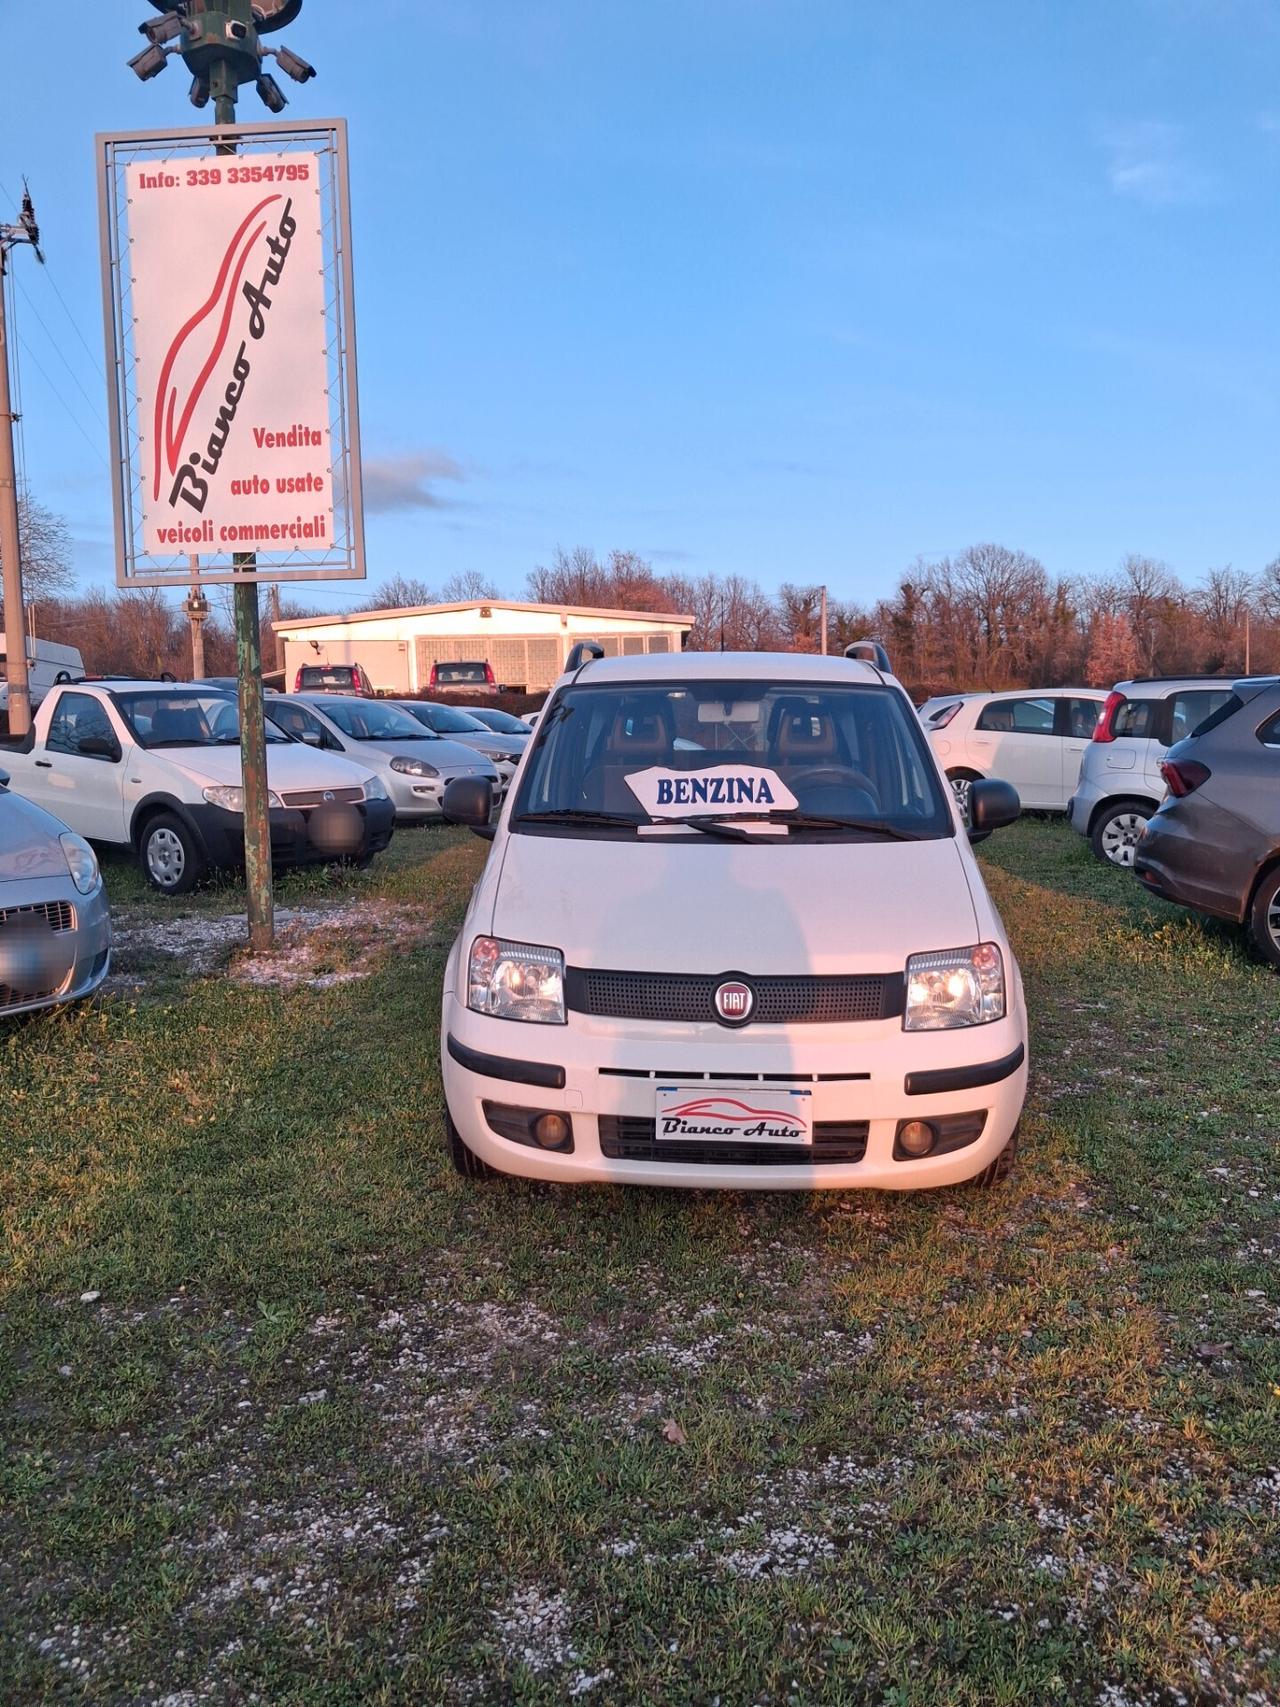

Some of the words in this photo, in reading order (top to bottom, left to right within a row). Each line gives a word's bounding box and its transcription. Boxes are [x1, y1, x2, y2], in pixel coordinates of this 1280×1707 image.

[139, 172, 181, 190] Info:
[186, 169, 221, 187] 339
[227, 164, 309, 184] 3354795
[168, 341, 251, 513] Bianco
[242, 197, 297, 340] Auto
[253, 424, 322, 448] Vendita
[230, 474, 270, 496] auto
[276, 471, 323, 493] usate
[157, 520, 214, 544] veicoli
[220, 515, 325, 541] commerciali
[656, 777, 775, 804] BENZINA
[723, 991, 746, 1010] FIAT
[661, 1117, 741, 1135] Bianco
[743, 1121, 806, 1138] Auto
